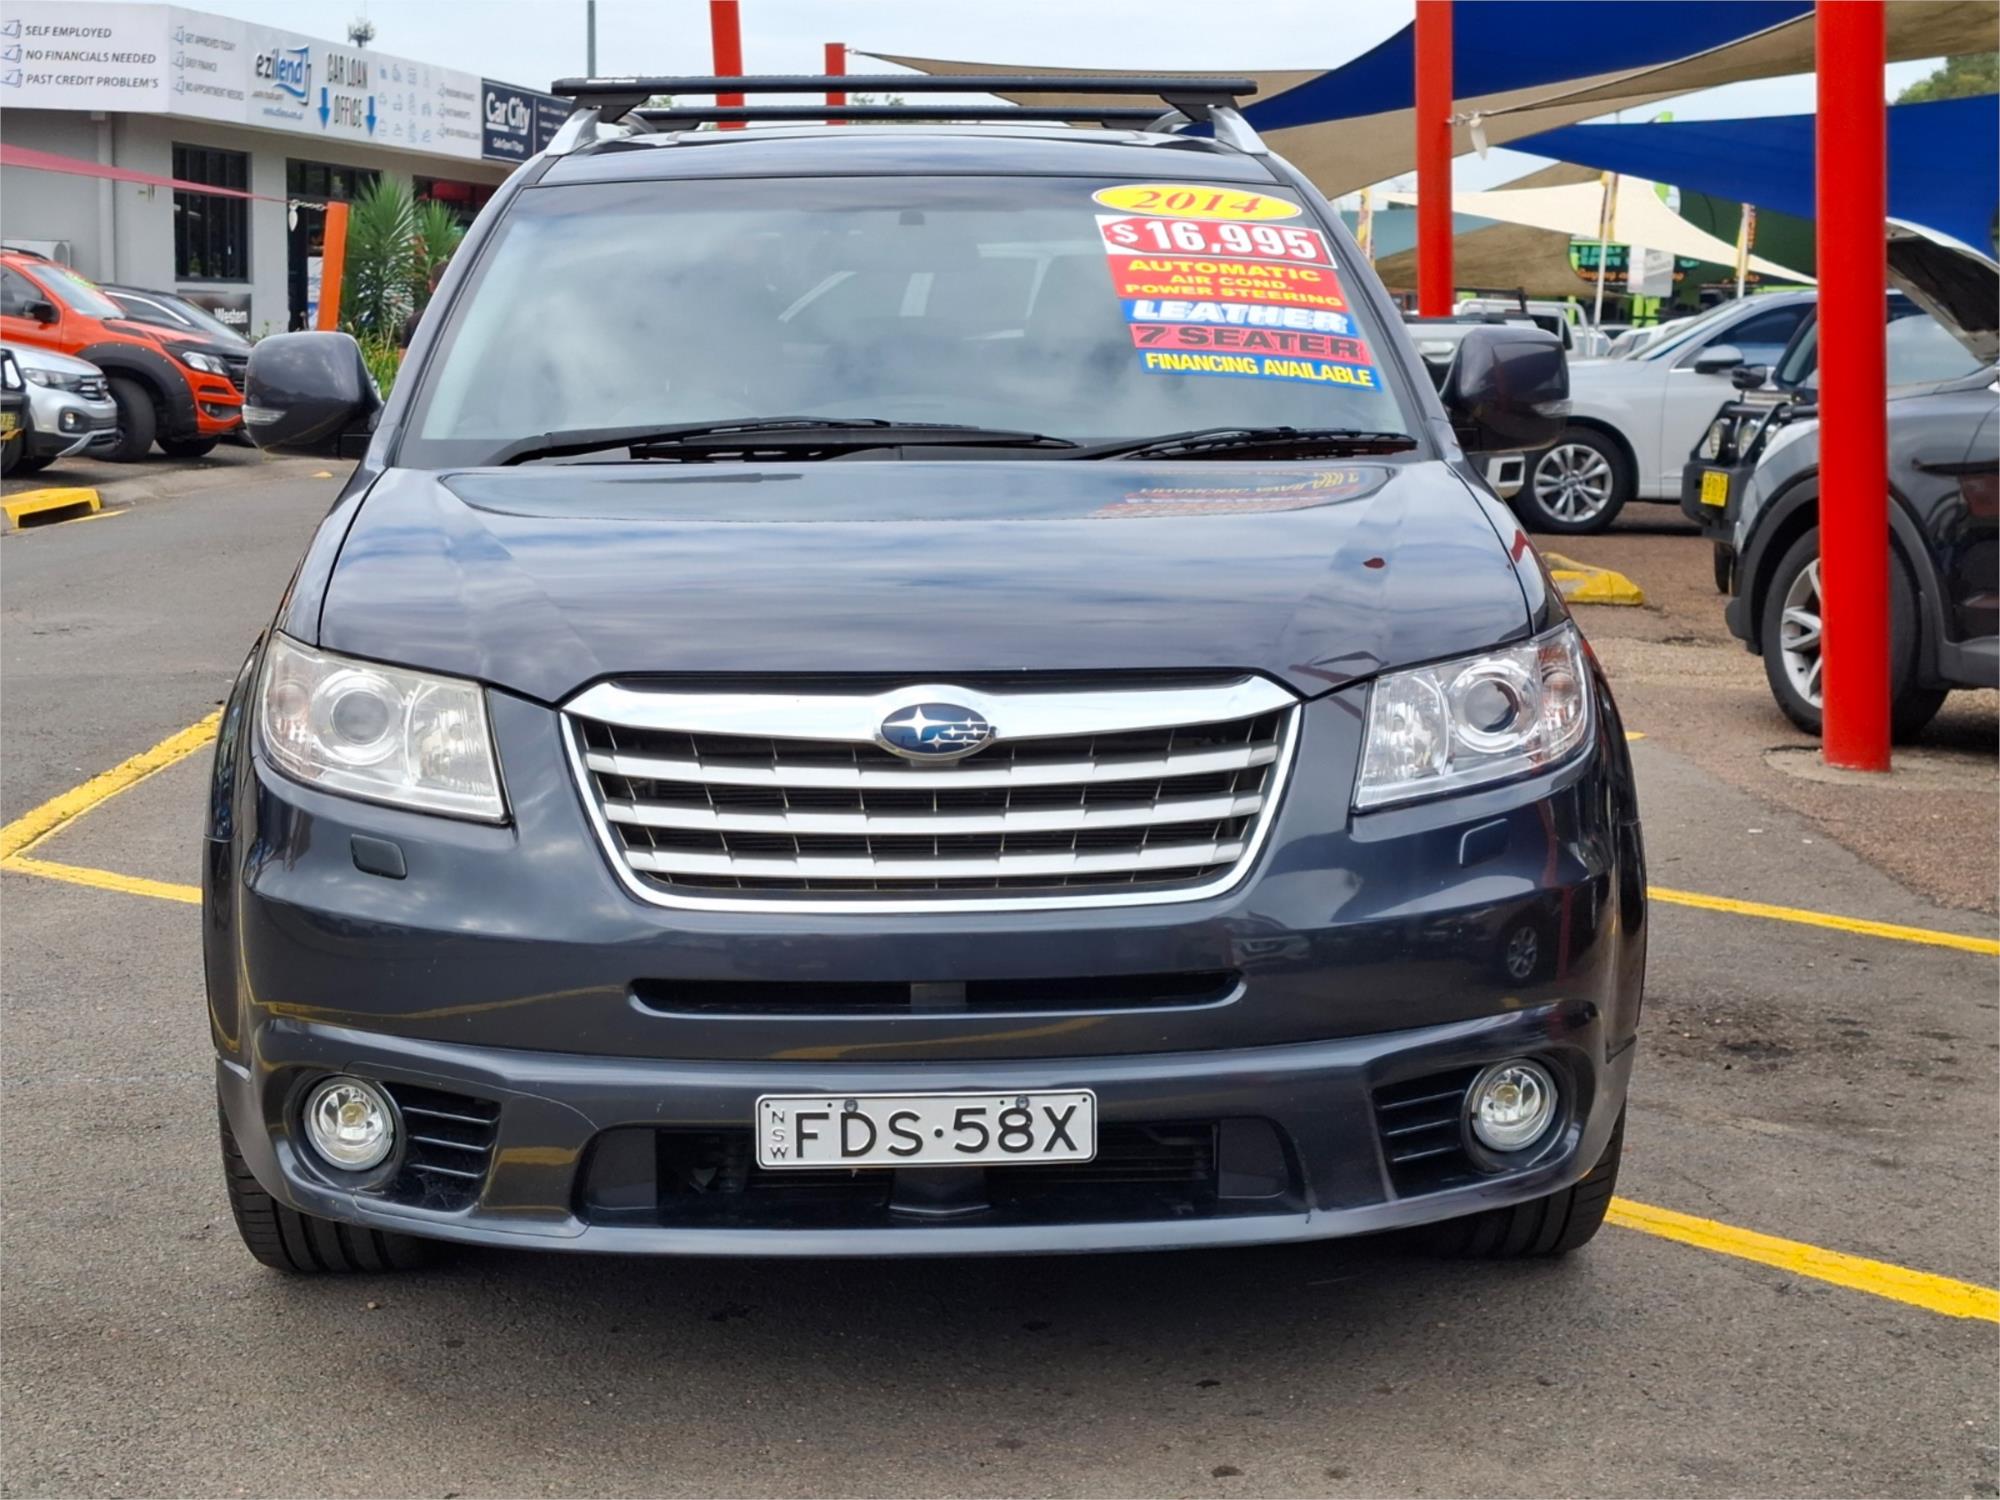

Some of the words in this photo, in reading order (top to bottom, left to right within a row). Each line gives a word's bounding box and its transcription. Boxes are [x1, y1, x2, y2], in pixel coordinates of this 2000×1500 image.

[25, 25, 51, 37] SELF
[52, 26, 112, 38] EMPLOYED
[25, 49, 43, 60] NO
[44, 50, 109, 63] FINANCIALS
[111, 53, 156, 64] NEEDED
[255, 47, 306, 84] ezilend
[26, 74, 52, 85] PAST
[54, 74, 94, 86] CREDIT
[96, 76, 159, 88] PROBLEM'S
[327, 53, 344, 85] CAR
[346, 57, 368, 89] LOAN
[333, 94, 362, 128] OFFICE
[485, 91, 507, 123] Car
[507, 96, 531, 135] City
[1131, 190, 1261, 213] 2014
[1128, 259, 1321, 282] AUTOMATIC
[1170, 274, 1212, 285] AIR
[1219, 276, 1294, 290] COND.
[1125, 284, 1214, 296] POWER
[1220, 288, 1343, 307] STEERING
[1132, 299, 1349, 333] LEATHER
[1136, 325, 1166, 344] 7
[1177, 326, 1361, 358] SEATER
[1145, 352, 1259, 375] FINANCING
[1264, 359, 1375, 387] AVAILABLE
